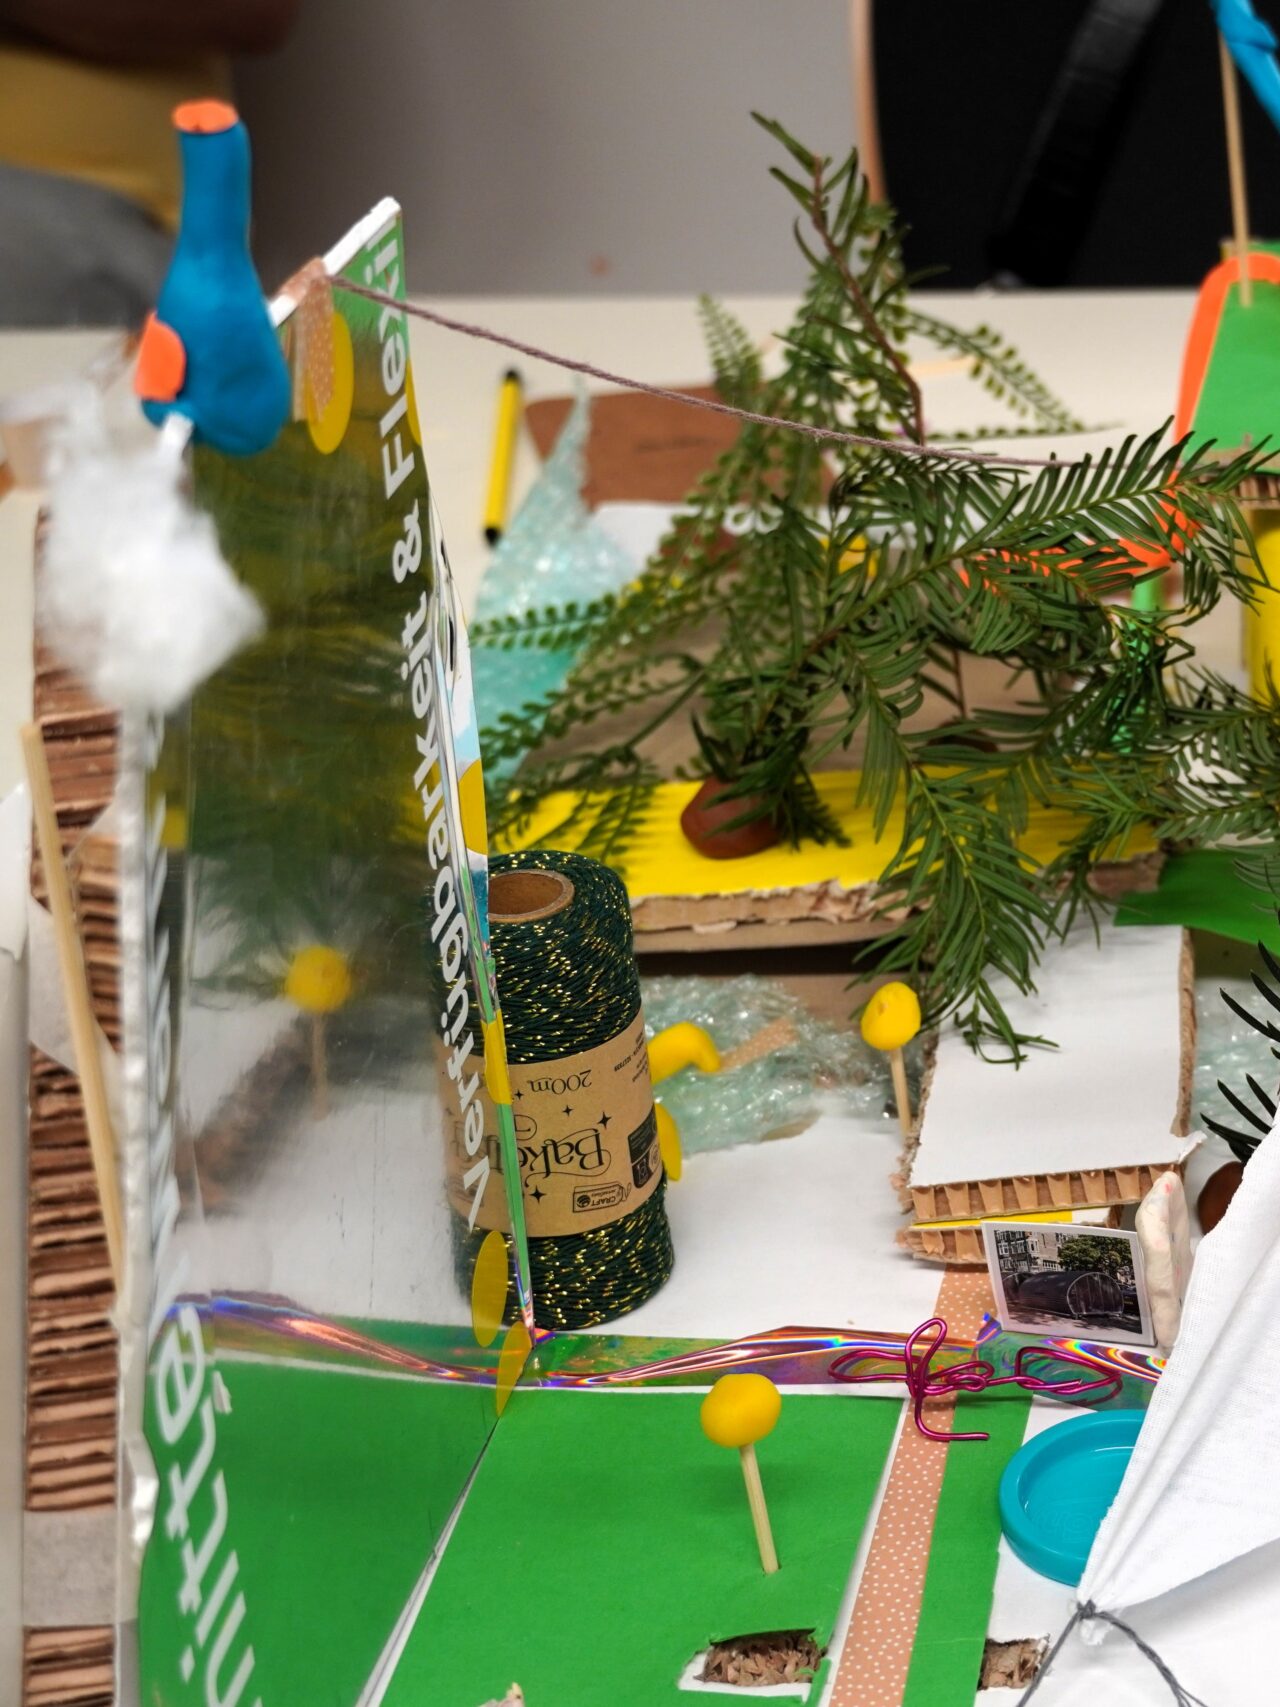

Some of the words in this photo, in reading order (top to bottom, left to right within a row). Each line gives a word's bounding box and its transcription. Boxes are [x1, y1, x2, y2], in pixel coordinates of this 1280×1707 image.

[393, 499, 422, 583] &
[401, 591, 491, 1229] Verfügbarkeit
[527, 1069, 593, 1096] 200m
[590, 1196, 617, 1207] CRAFT
